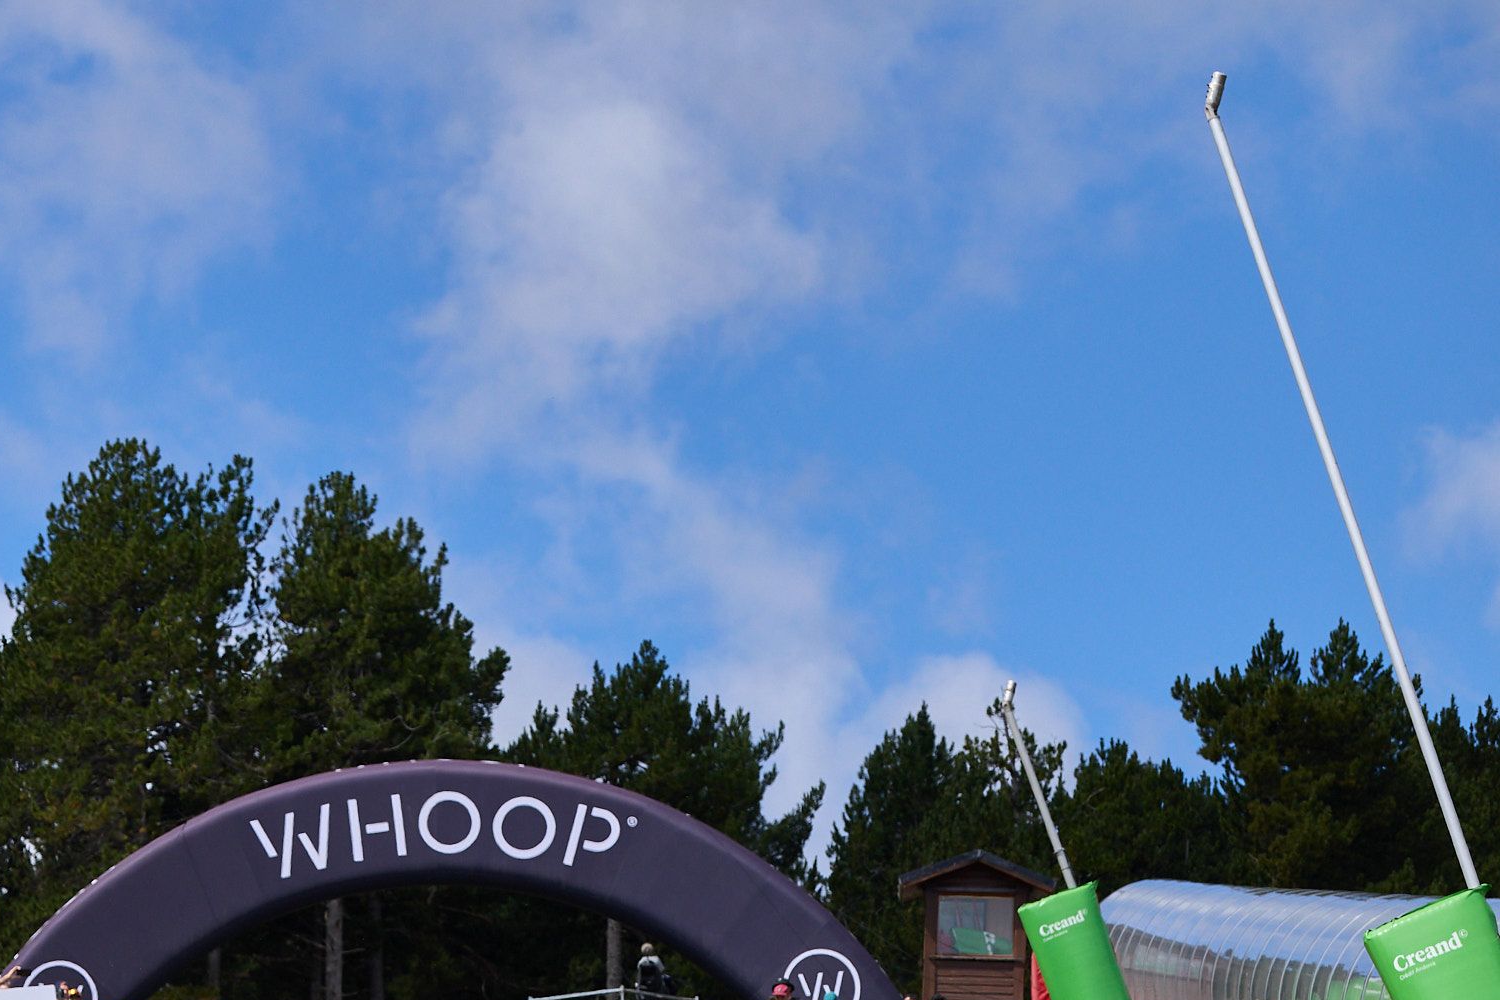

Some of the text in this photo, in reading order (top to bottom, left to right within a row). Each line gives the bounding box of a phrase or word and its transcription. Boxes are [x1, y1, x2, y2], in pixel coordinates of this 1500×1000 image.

[249, 791, 621, 878] WHOOP
[1039, 910, 1085, 937] Creand
[1393, 931, 1463, 972] Creand
